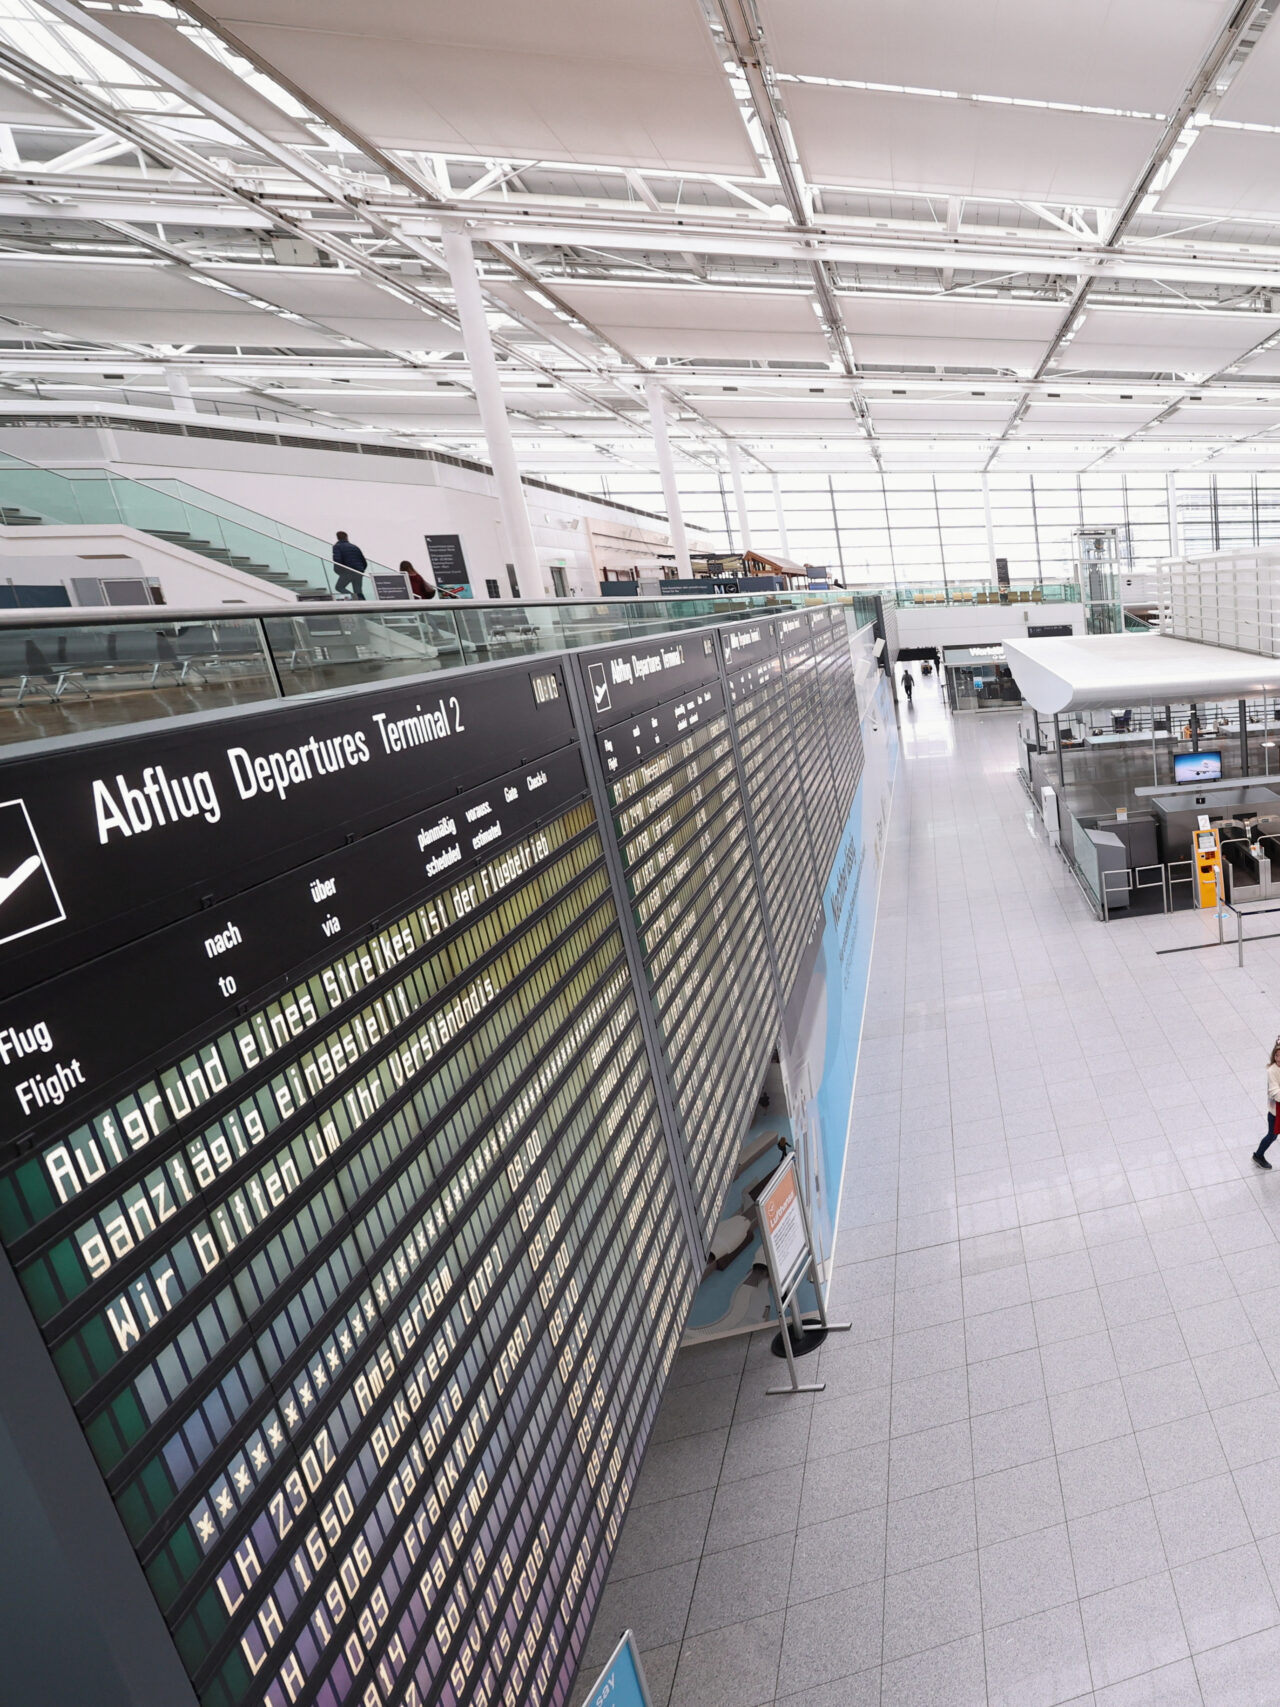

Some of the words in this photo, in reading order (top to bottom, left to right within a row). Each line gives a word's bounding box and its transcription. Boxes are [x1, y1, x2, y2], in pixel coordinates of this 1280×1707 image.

[631, 655, 661, 679] Departures
[94, 768, 219, 841] Abflug
[229, 732, 369, 798] Departures
[373, 701, 450, 752] Terminal
[449, 696, 464, 732] 2
[503, 787, 518, 802] Gate
[418, 817, 456, 851] planmäßig
[465, 801, 492, 822] vorauss.
[472, 821, 501, 849] estimated
[310, 878, 336, 902] über
[426, 843, 461, 876] scheduled
[205, 922, 241, 957] nach
[322, 914, 340, 936] via
[47, 1048, 226, 1199] Aufgrund
[239, 995, 316, 1067] eines
[323, 929, 414, 1006] Streikes
[420, 900, 448, 940] ist
[453, 885, 475, 917] der
[481, 835, 548, 896] Flugbetrieb
[218, 976, 236, 997] to
[0, 1022, 52, 1063] Flug
[16, 1060, 84, 1113] Flight
[83, 1110, 263, 1275] ganztägig
[276, 988, 417, 1117] eingestellt.
[108, 1268, 173, 1350] Wir
[193, 1153, 299, 1270] bitten
[308, 1115, 340, 1165] um
[347, 1079, 381, 1127] Ihr
[217, 1538, 261, 1615] LH
[270, 1429, 335, 1537] 2302
[355, 1260, 451, 1412] Amsterdam
[507, 1130, 541, 1191] 09:00
[241, 1597, 283, 1674] LH
[295, 1483, 353, 1589] 1650
[372, 1321, 455, 1464] Bukarest
[518, 1168, 551, 1231] 09:00
[315, 1535, 371, 1643] 1906
[389, 1378, 461, 1513] Catania
[529, 1205, 560, 1270] 09:00
[421, 1465, 487, 1607] Palermo
[549, 1278, 578, 1345] 09:10
[587, 1414, 613, 1487] 09:55
[345, 1586, 388, 1674] 099
[405, 1393, 488, 1560] Frankfurt
[539, 1242, 569, 1308] 09:00
[436, 1541, 485, 1653] Sofia
[559, 1313, 587, 1382] 09:15
[597, 1446, 621, 1518] 10:00
[451, 1548, 512, 1696] Sevilla
[568, 1347, 596, 1418] 09:25
[470, 1623, 510, 1707] aris
[578, 1381, 604, 1453] 09:45
[606, 1478, 629, 1551] 10:15
